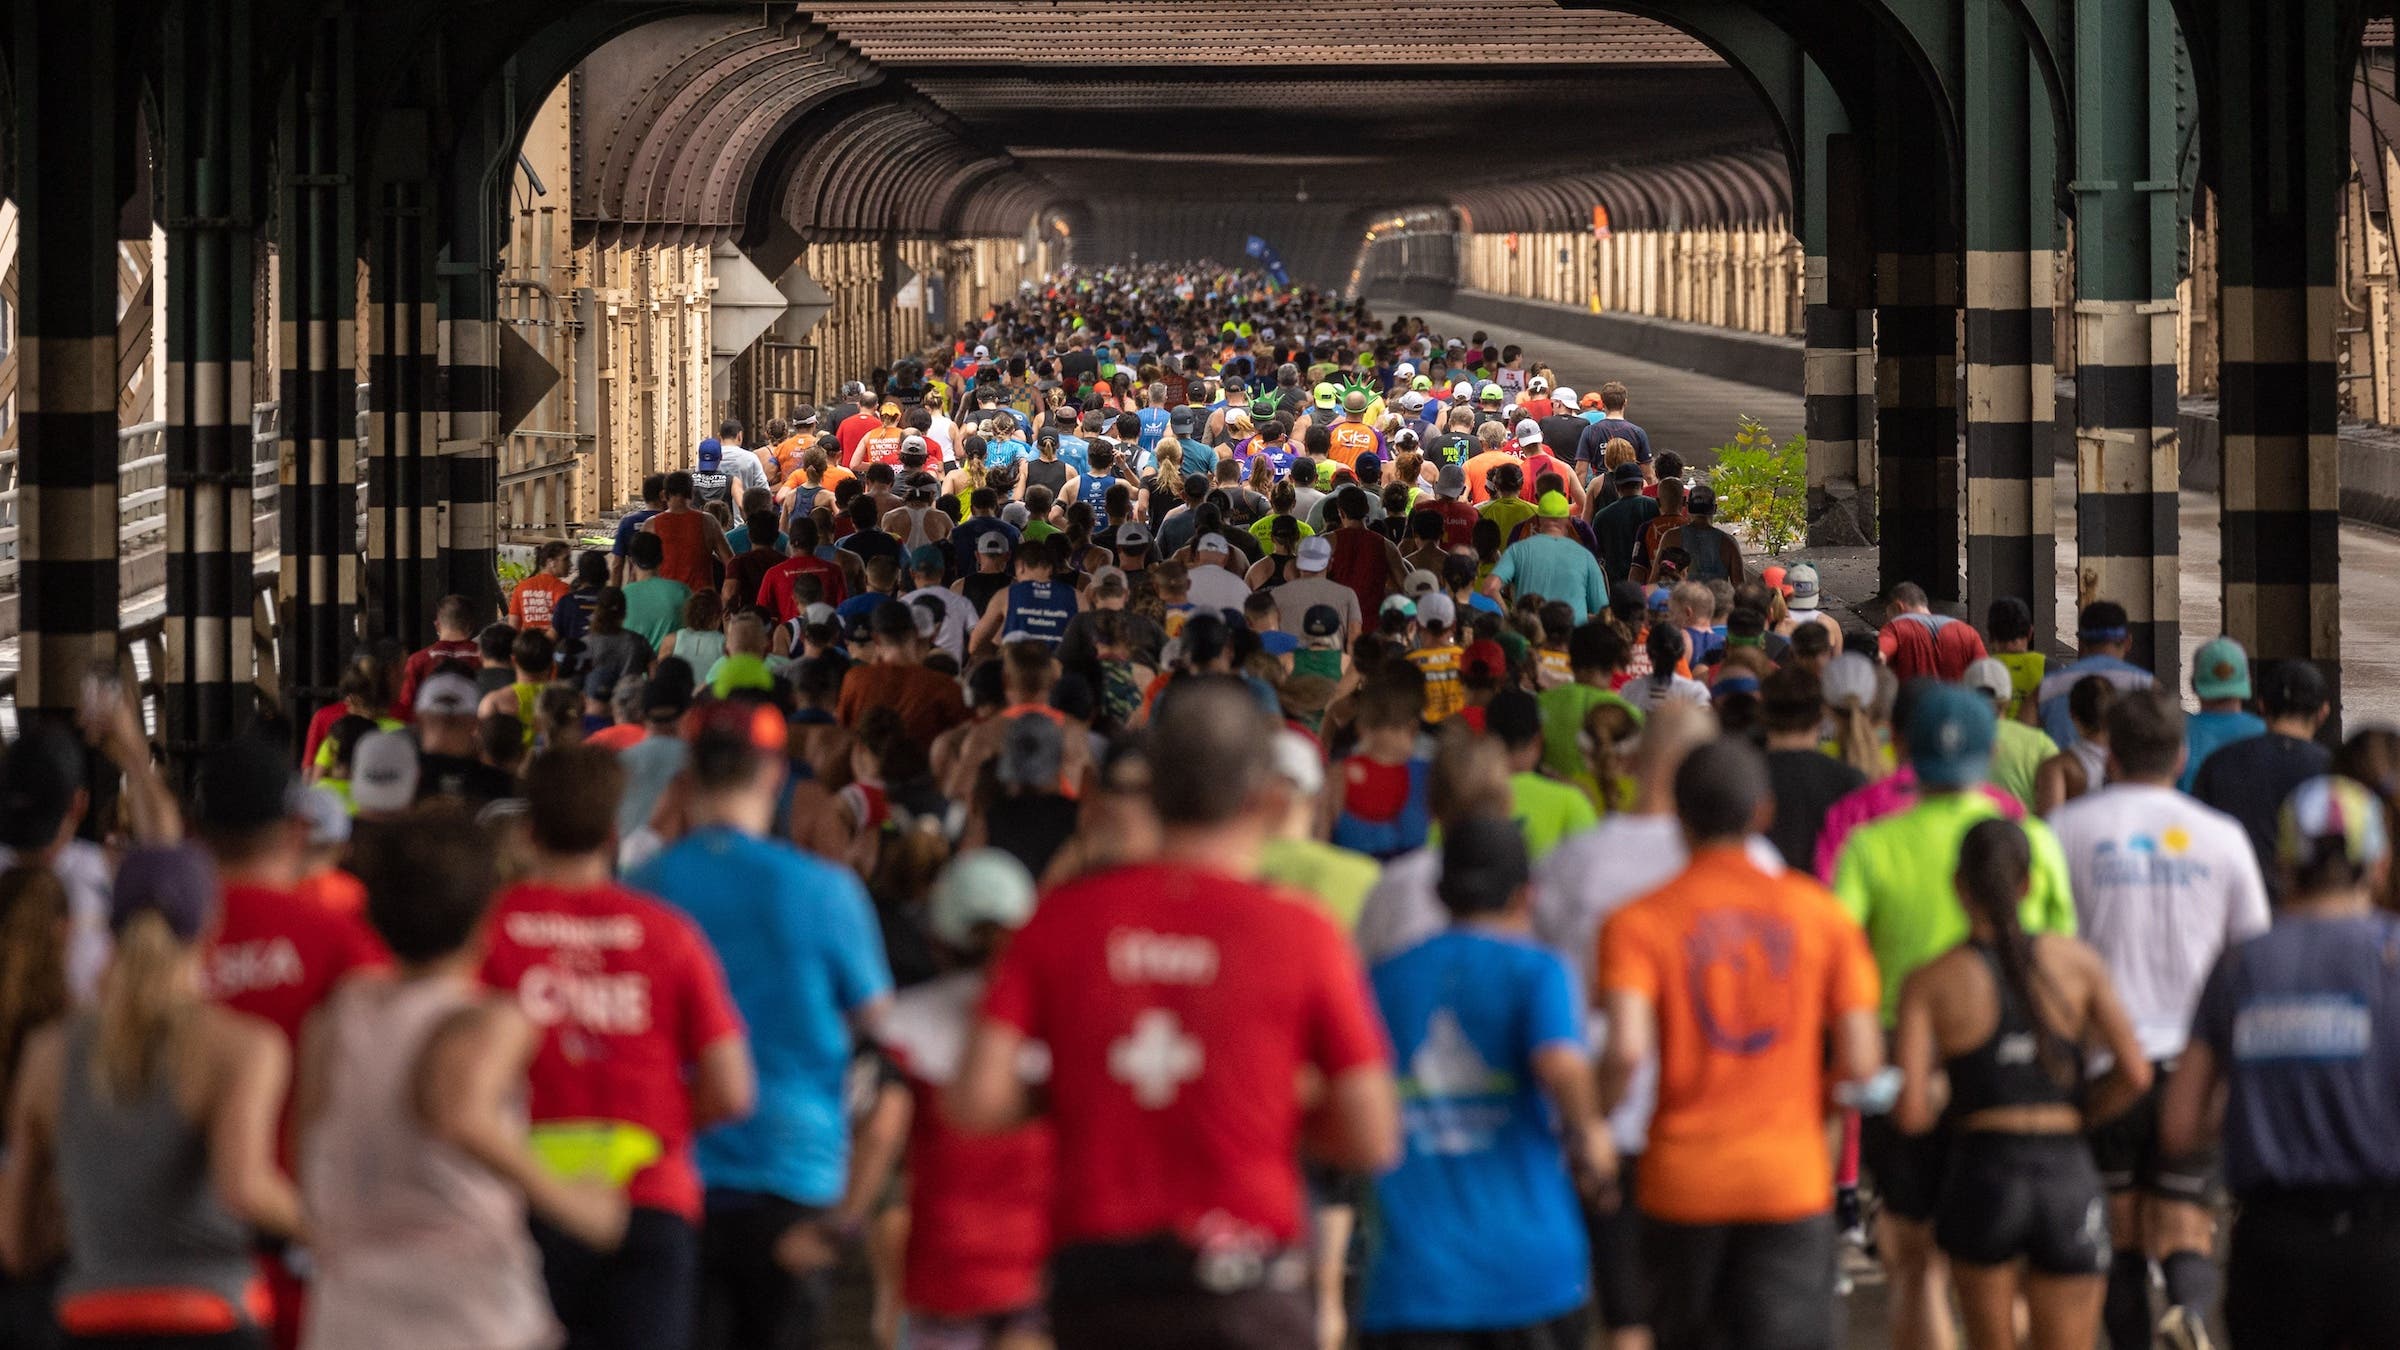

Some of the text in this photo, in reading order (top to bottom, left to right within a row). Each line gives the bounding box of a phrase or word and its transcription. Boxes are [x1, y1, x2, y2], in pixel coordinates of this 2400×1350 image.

[1337, 429, 1370, 443] Kika
[1442, 447, 1458, 456] RUN
[1016, 607, 1068, 618] Mental Health
[1027, 617, 1056, 626] Matters
